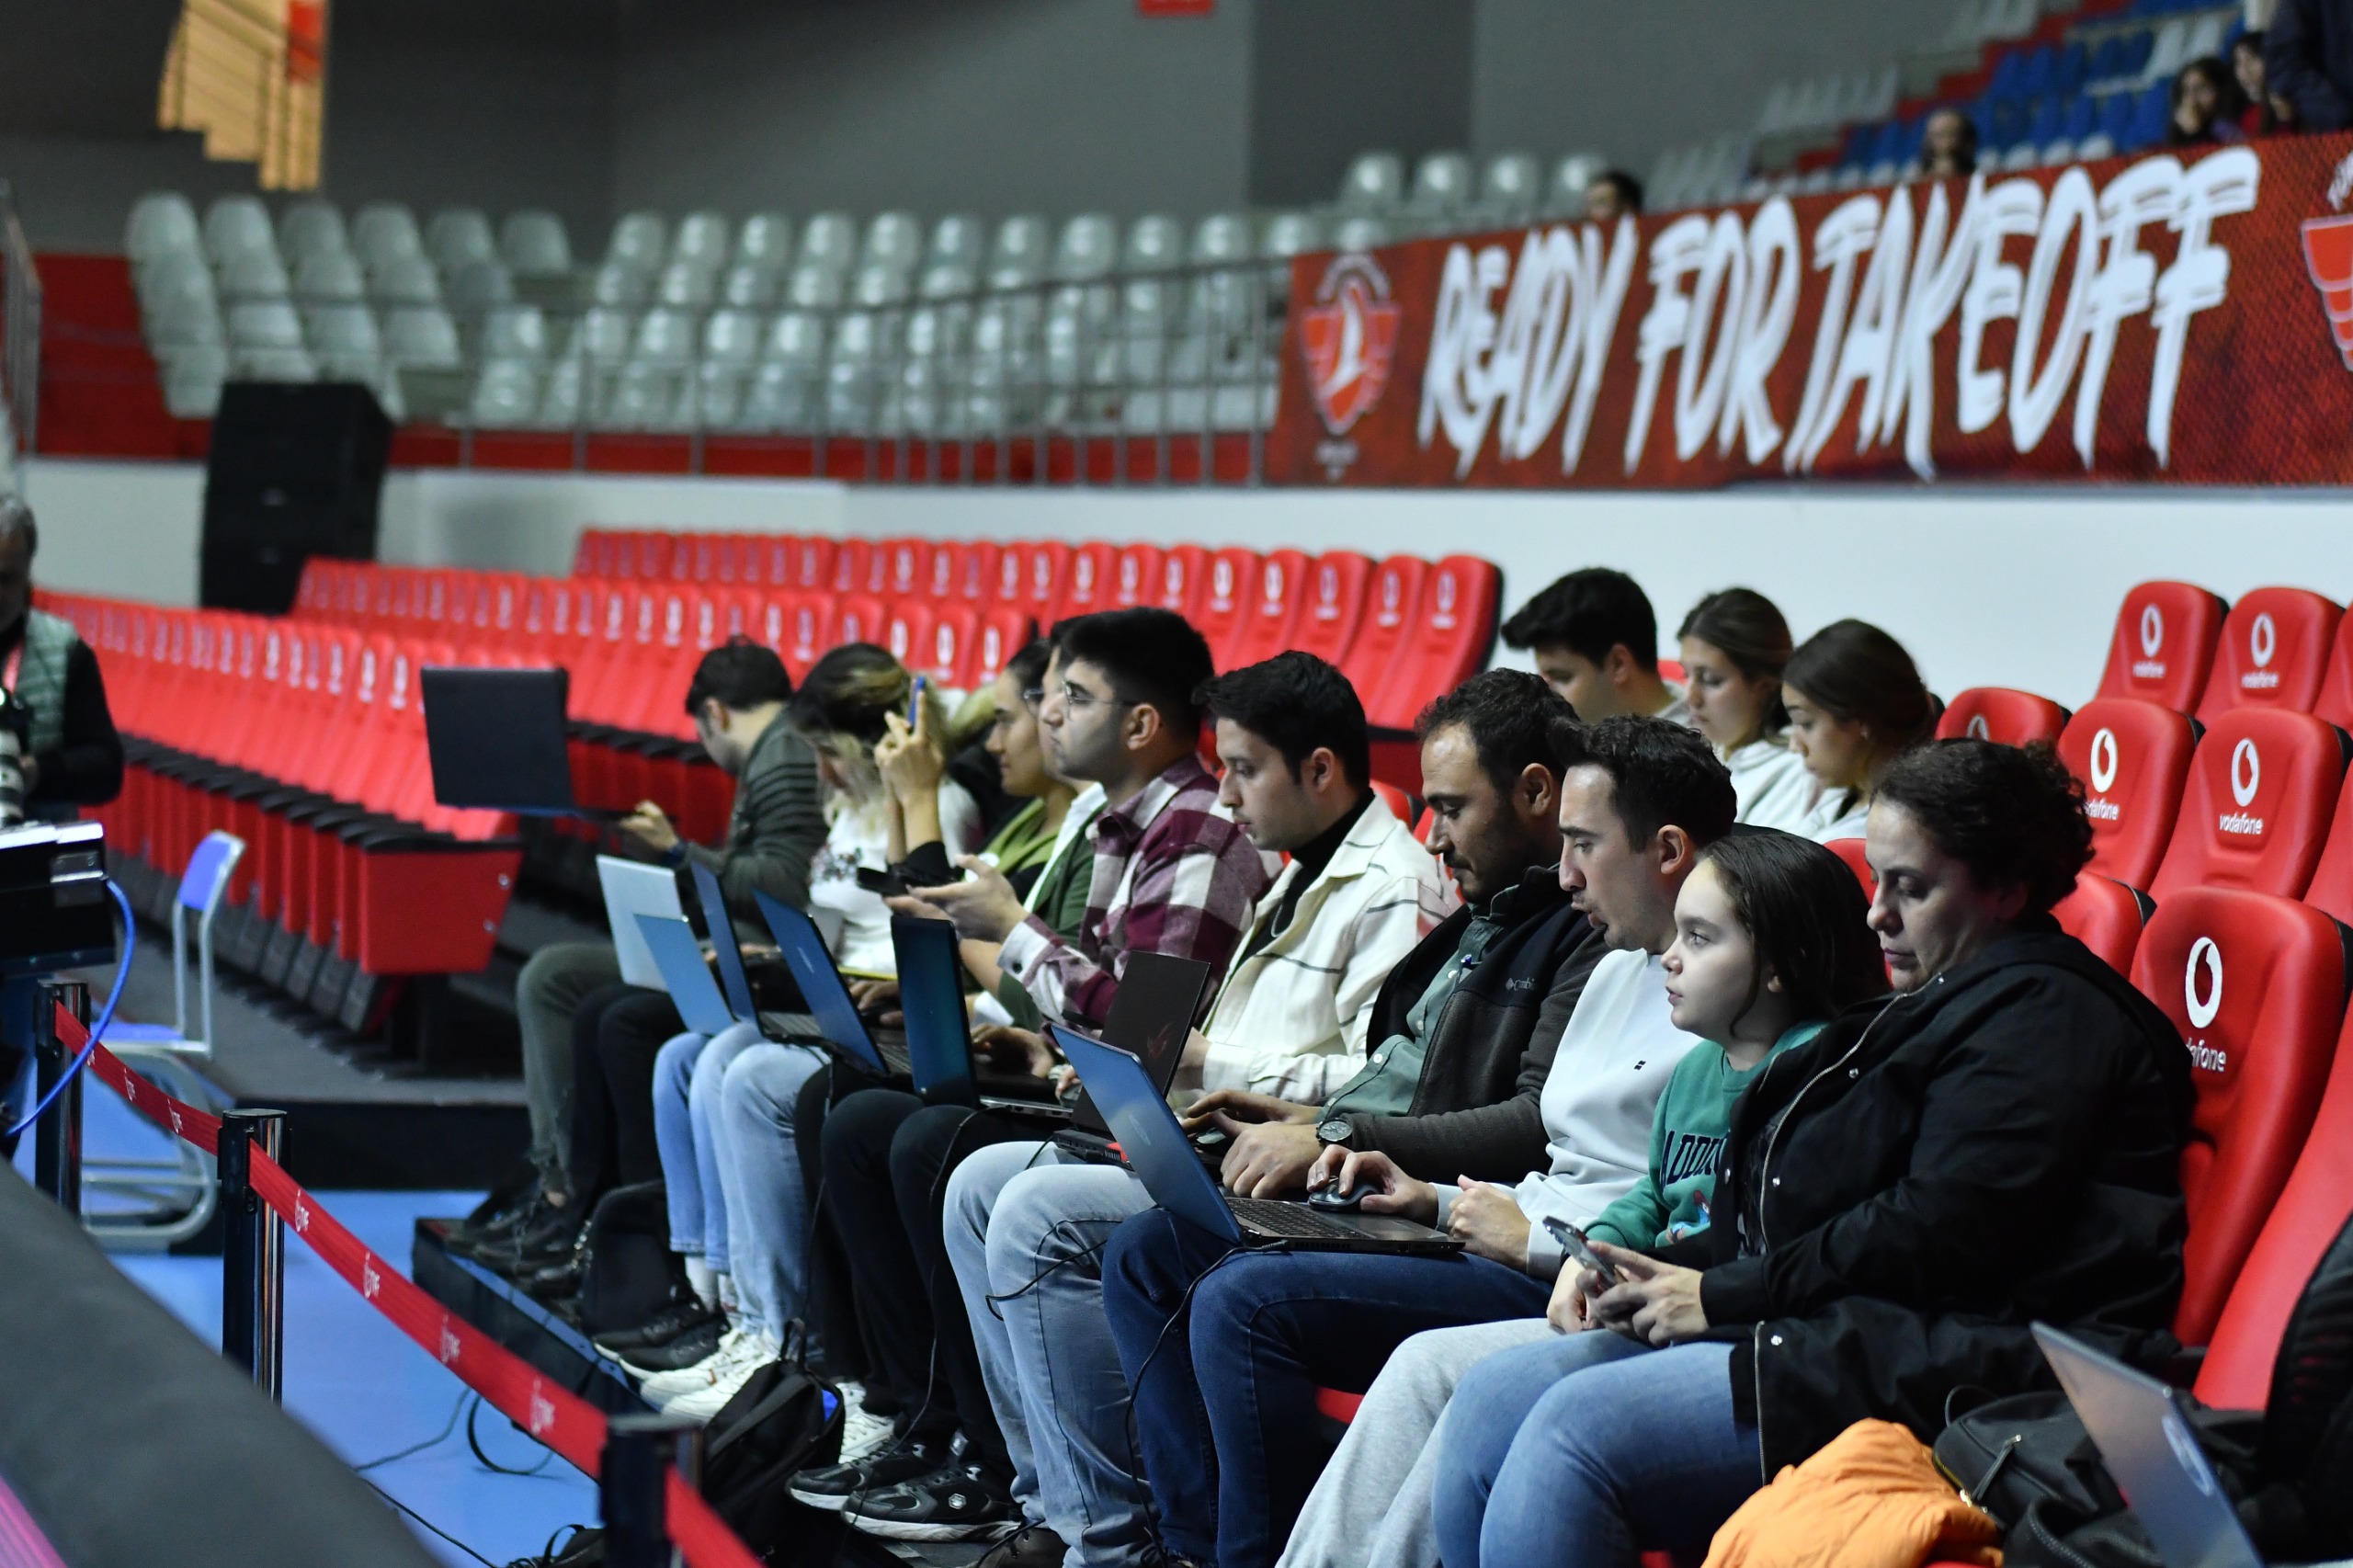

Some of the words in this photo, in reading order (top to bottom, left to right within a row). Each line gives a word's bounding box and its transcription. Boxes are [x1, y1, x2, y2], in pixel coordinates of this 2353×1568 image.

[1418, 215, 1638, 480] READY
[1622, 196, 1800, 477] FOR
[1781, 145, 2261, 482] TAKEOFF
[2219, 811, 2264, 835] vodafone
